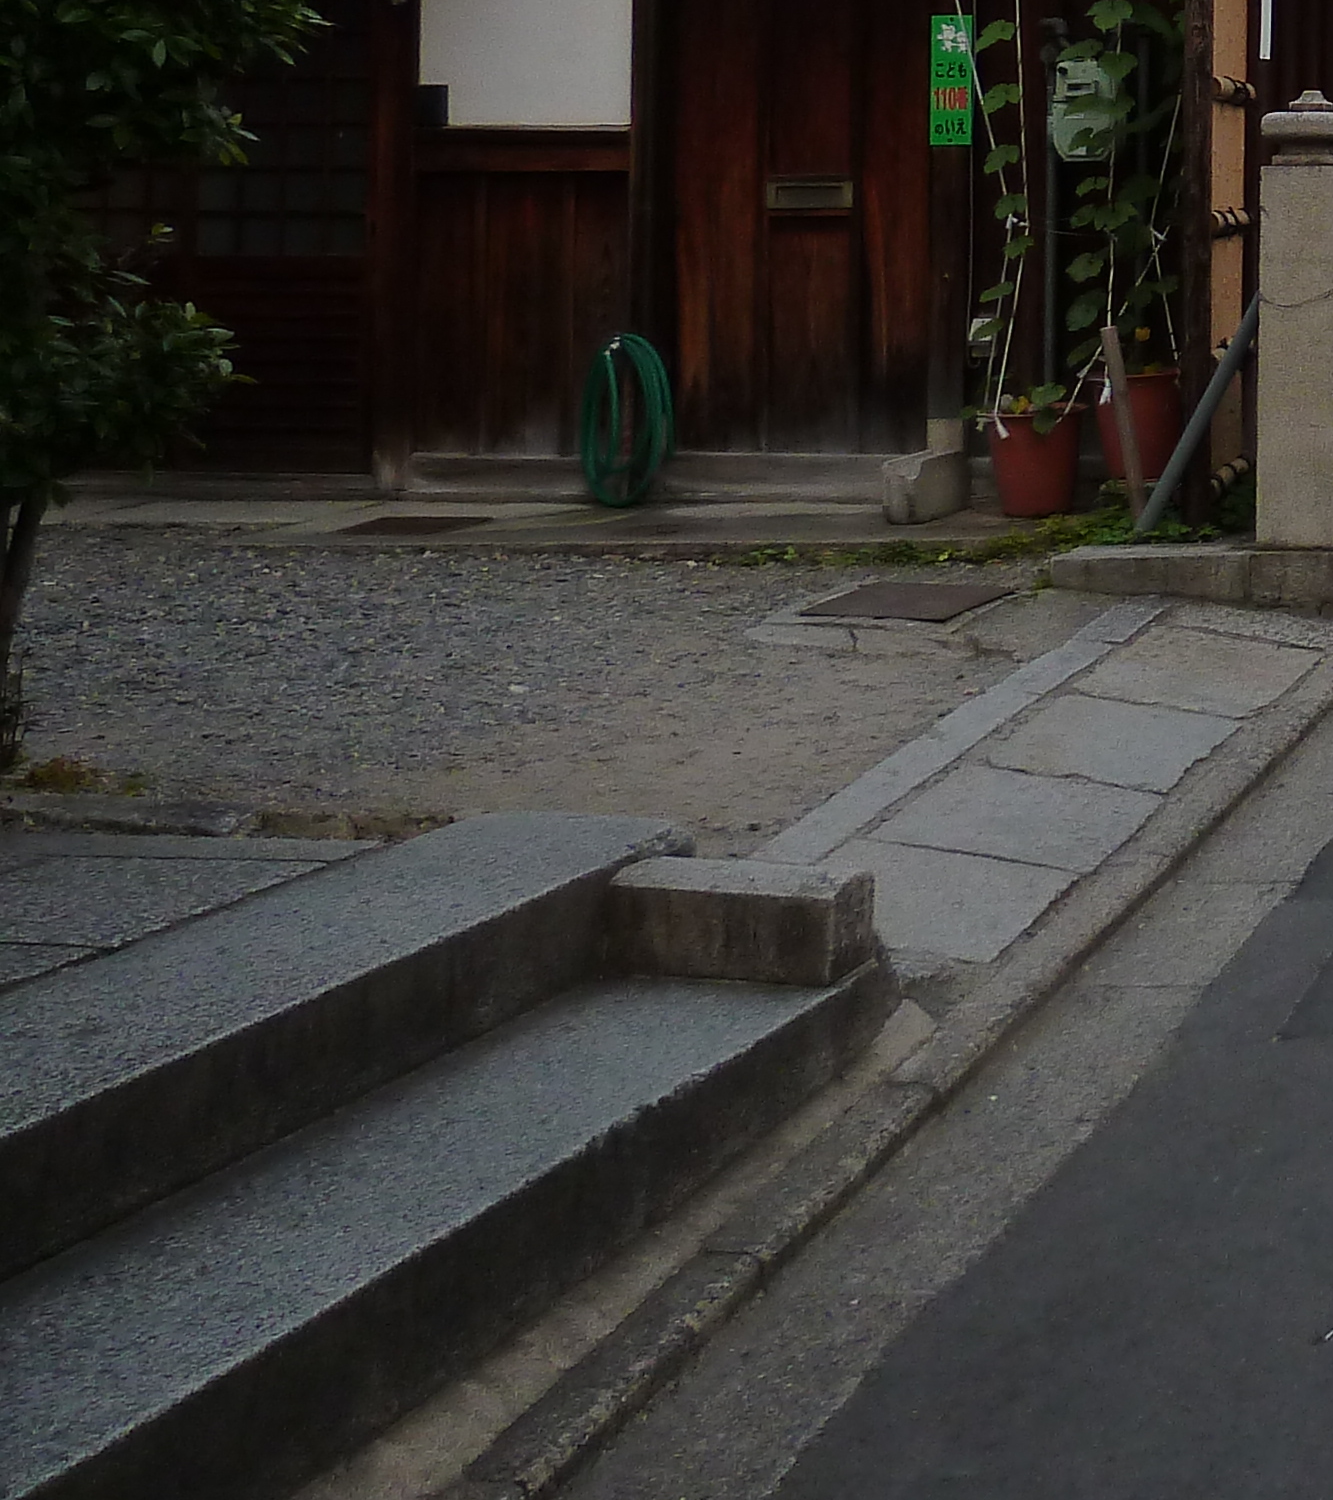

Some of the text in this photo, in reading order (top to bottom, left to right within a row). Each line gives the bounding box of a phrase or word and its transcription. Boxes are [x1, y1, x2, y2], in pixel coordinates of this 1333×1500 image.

[935, 62, 967, 79] こども
[934, 117, 967, 135] のいえ
